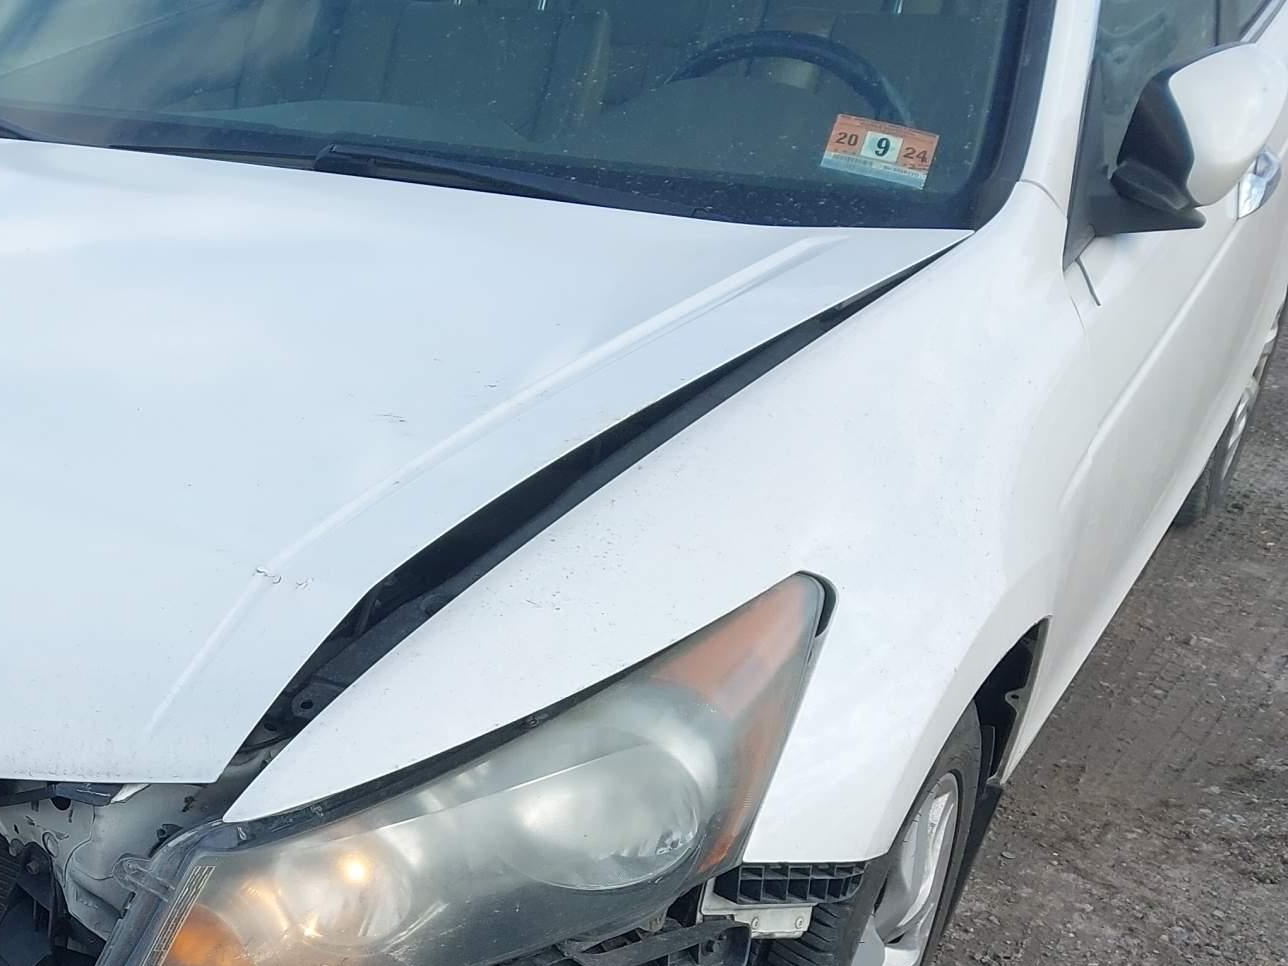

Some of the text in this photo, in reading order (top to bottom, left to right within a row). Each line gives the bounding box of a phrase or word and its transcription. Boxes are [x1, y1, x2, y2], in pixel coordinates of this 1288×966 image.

[835, 131, 928, 163] 20 9 24
